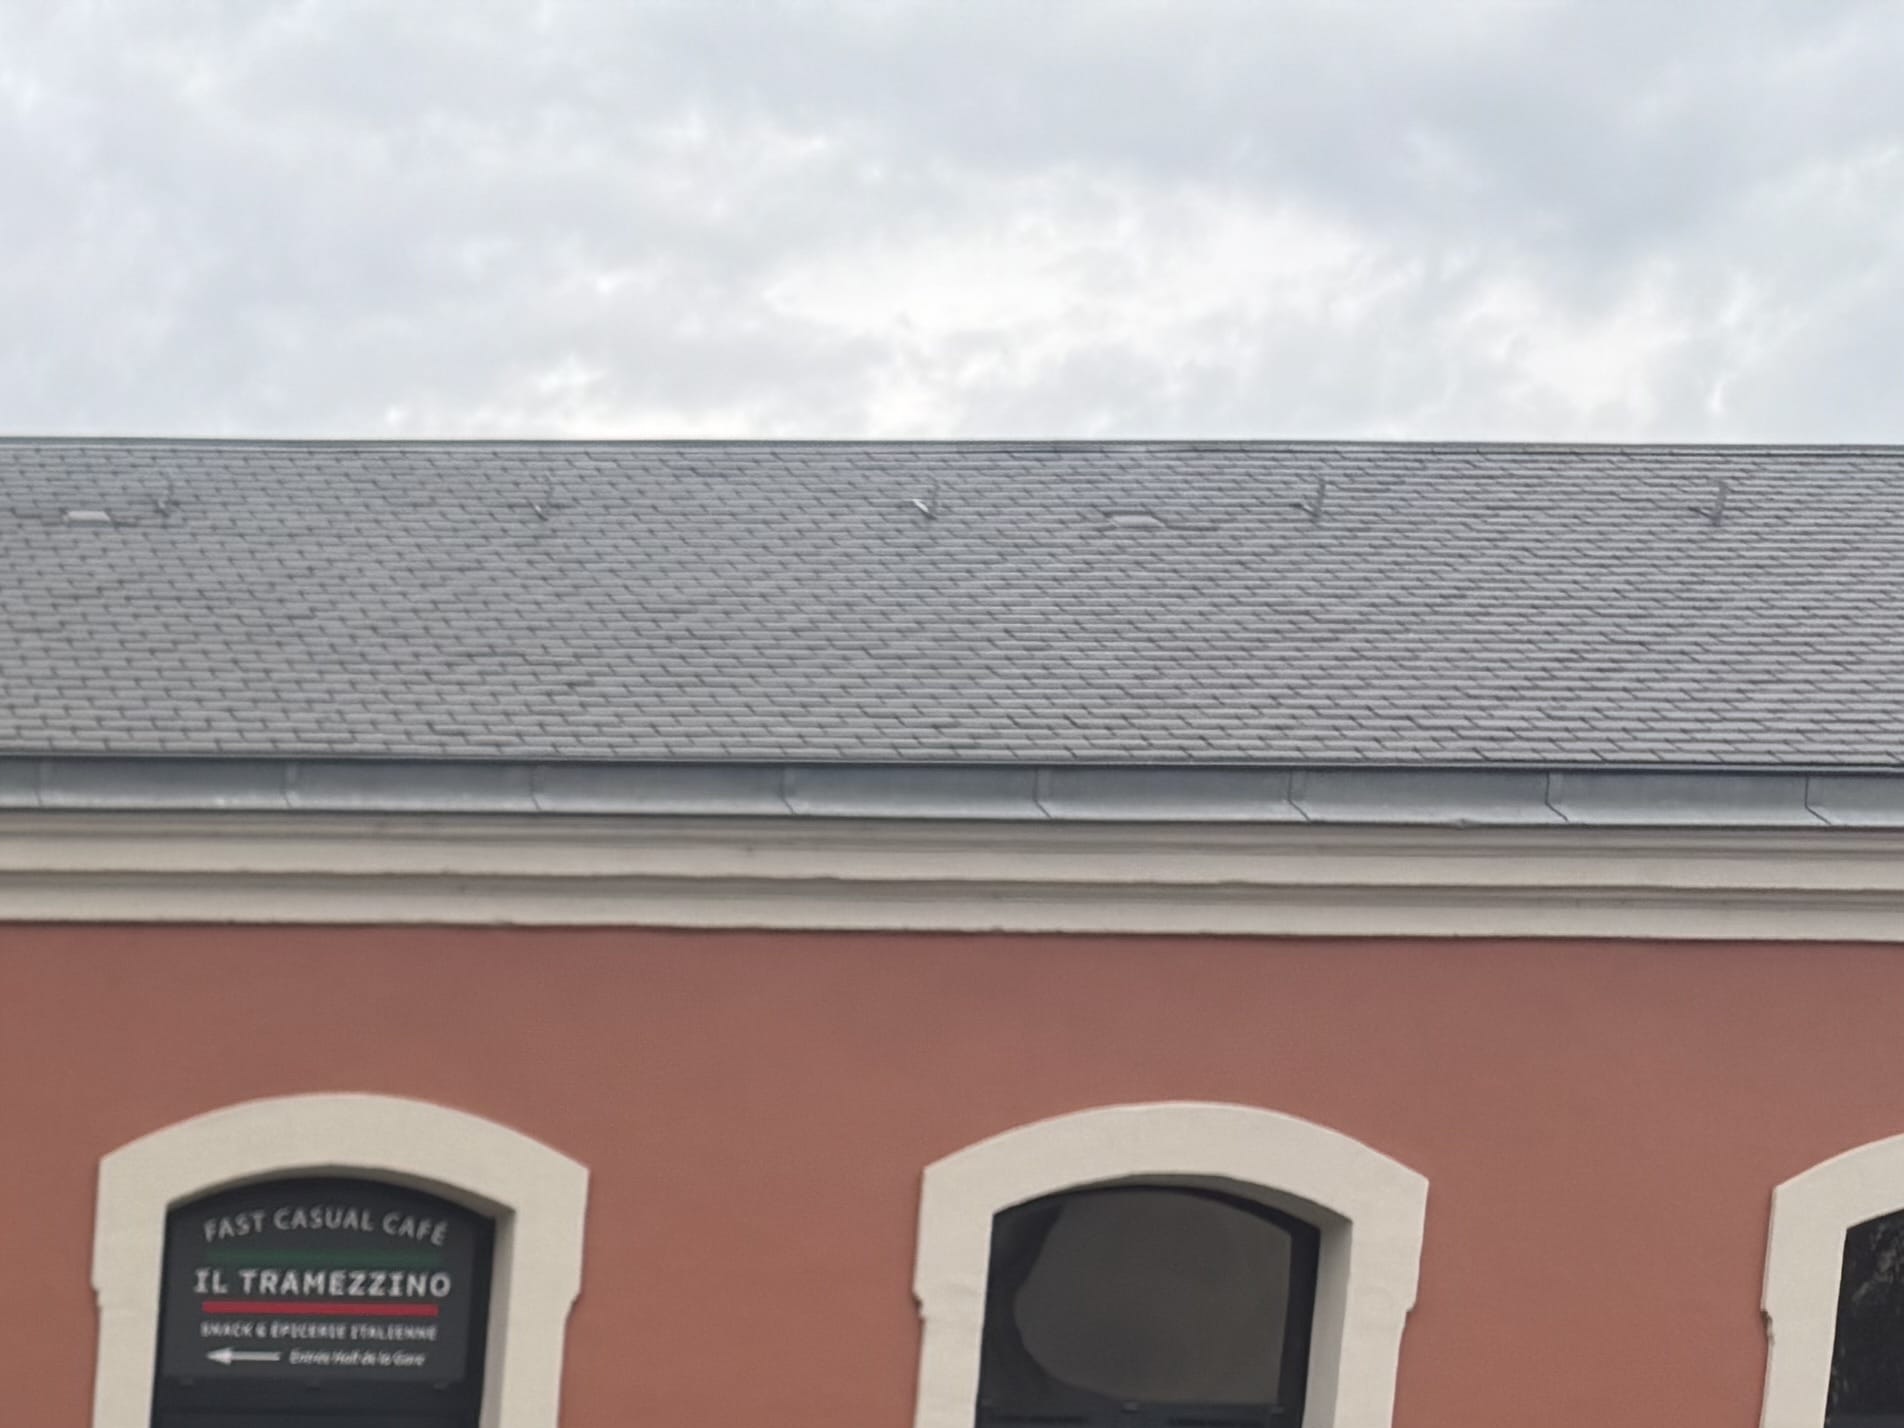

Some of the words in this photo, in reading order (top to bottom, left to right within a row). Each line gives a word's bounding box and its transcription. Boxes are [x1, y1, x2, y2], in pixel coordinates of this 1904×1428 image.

[203, 1210, 267, 1242] FAST
[273, 1204, 374, 1232] CASUAL
[193, 1267, 228, 1295] IL
[238, 1268, 452, 1298] TRAMEZZINO
